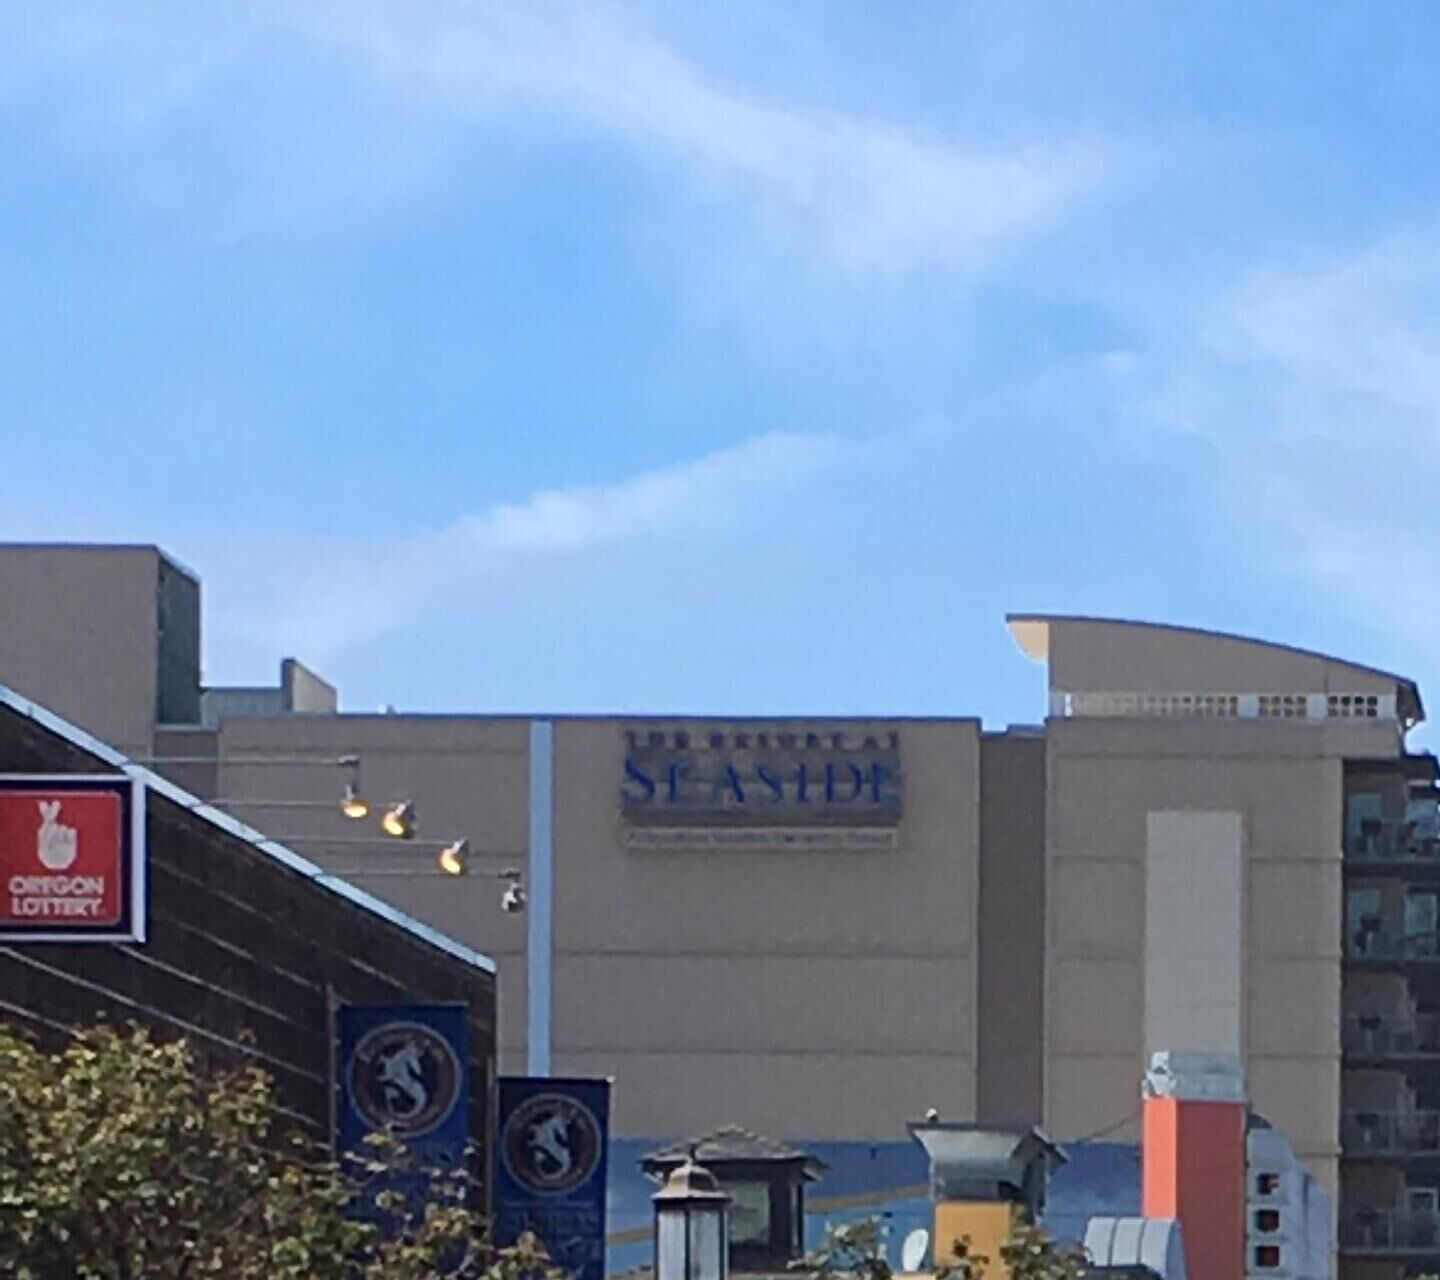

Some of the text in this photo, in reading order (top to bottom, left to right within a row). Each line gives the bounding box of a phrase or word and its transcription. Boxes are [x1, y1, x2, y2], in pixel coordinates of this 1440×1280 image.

[619, 758, 902, 803] SEASIDE
[8, 875, 105, 896] OREGON
[11, 897, 103, 917] LOTTERY
